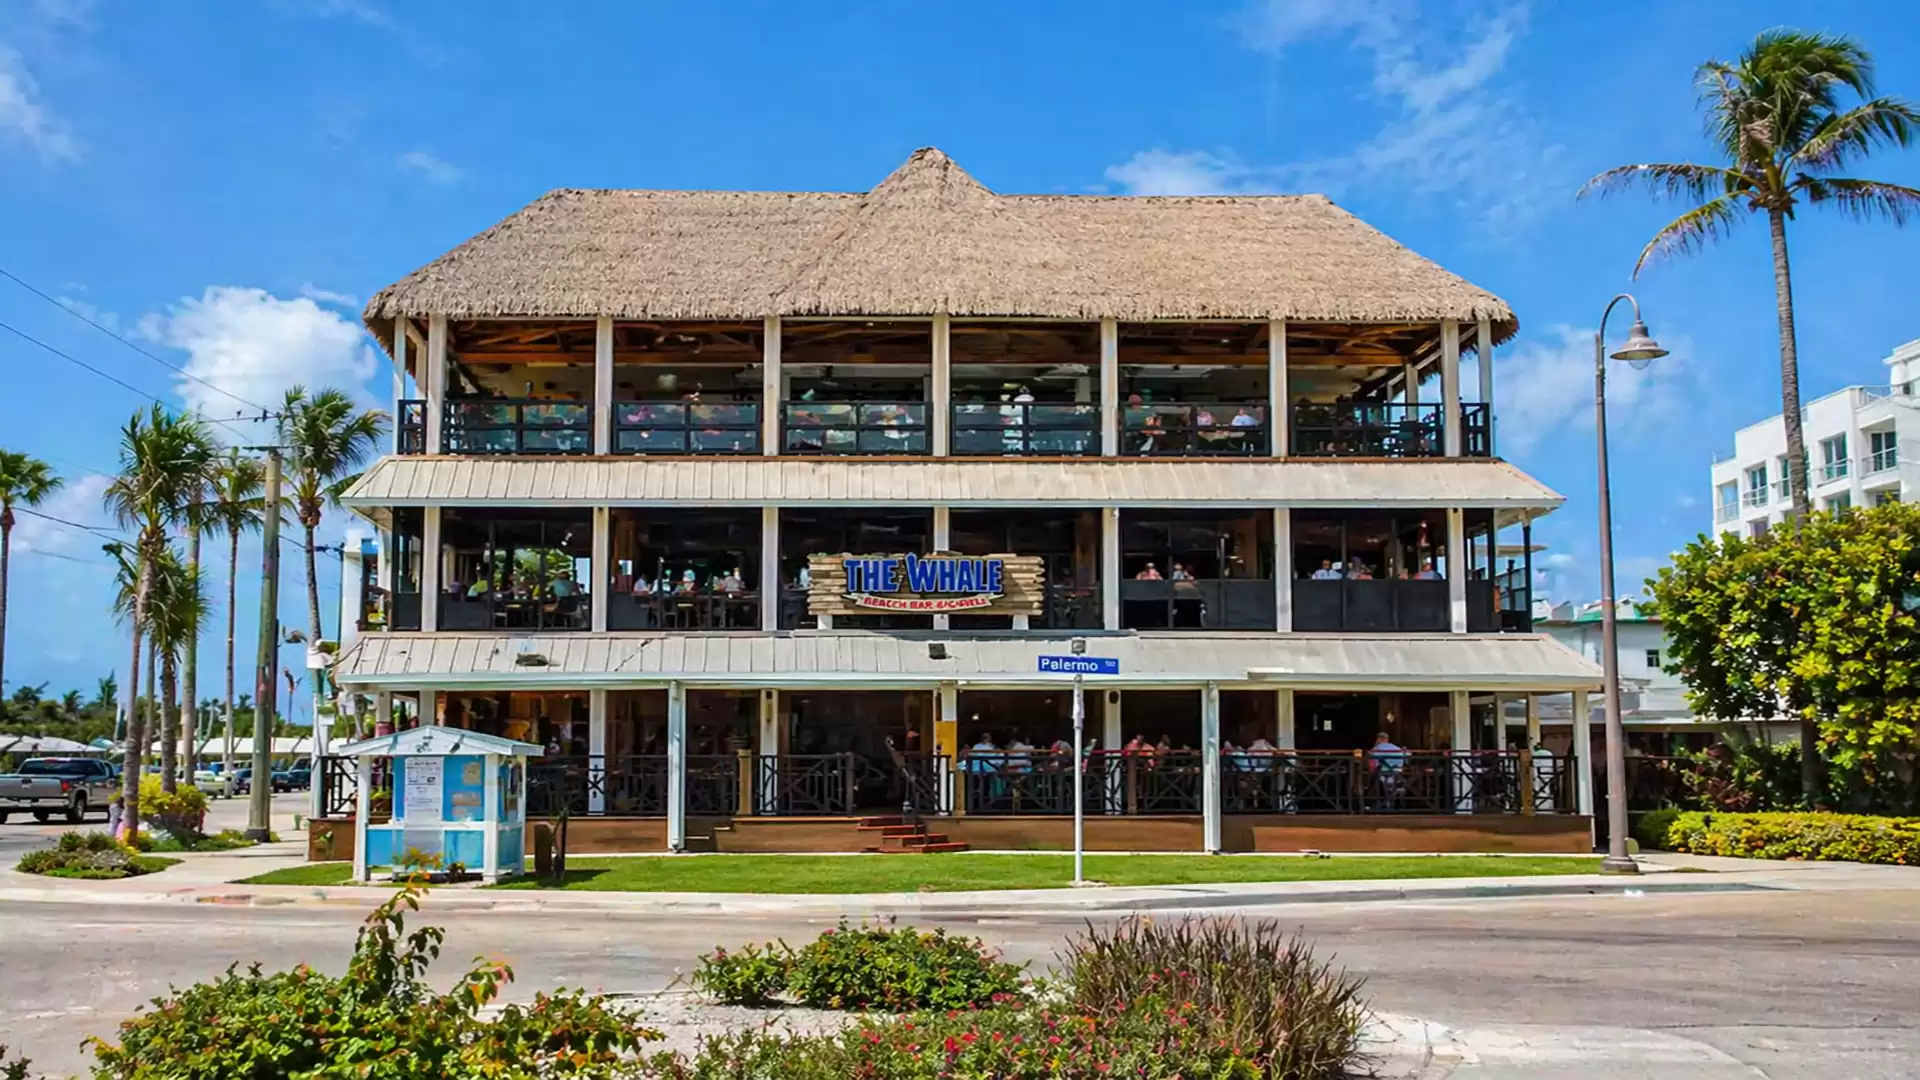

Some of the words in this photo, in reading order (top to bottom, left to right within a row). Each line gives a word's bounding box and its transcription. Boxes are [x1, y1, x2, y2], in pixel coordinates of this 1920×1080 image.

[844, 558, 899, 592] THE
[905, 552, 1002, 592] WHALE
[1041, 658, 1098, 671] Palermo
